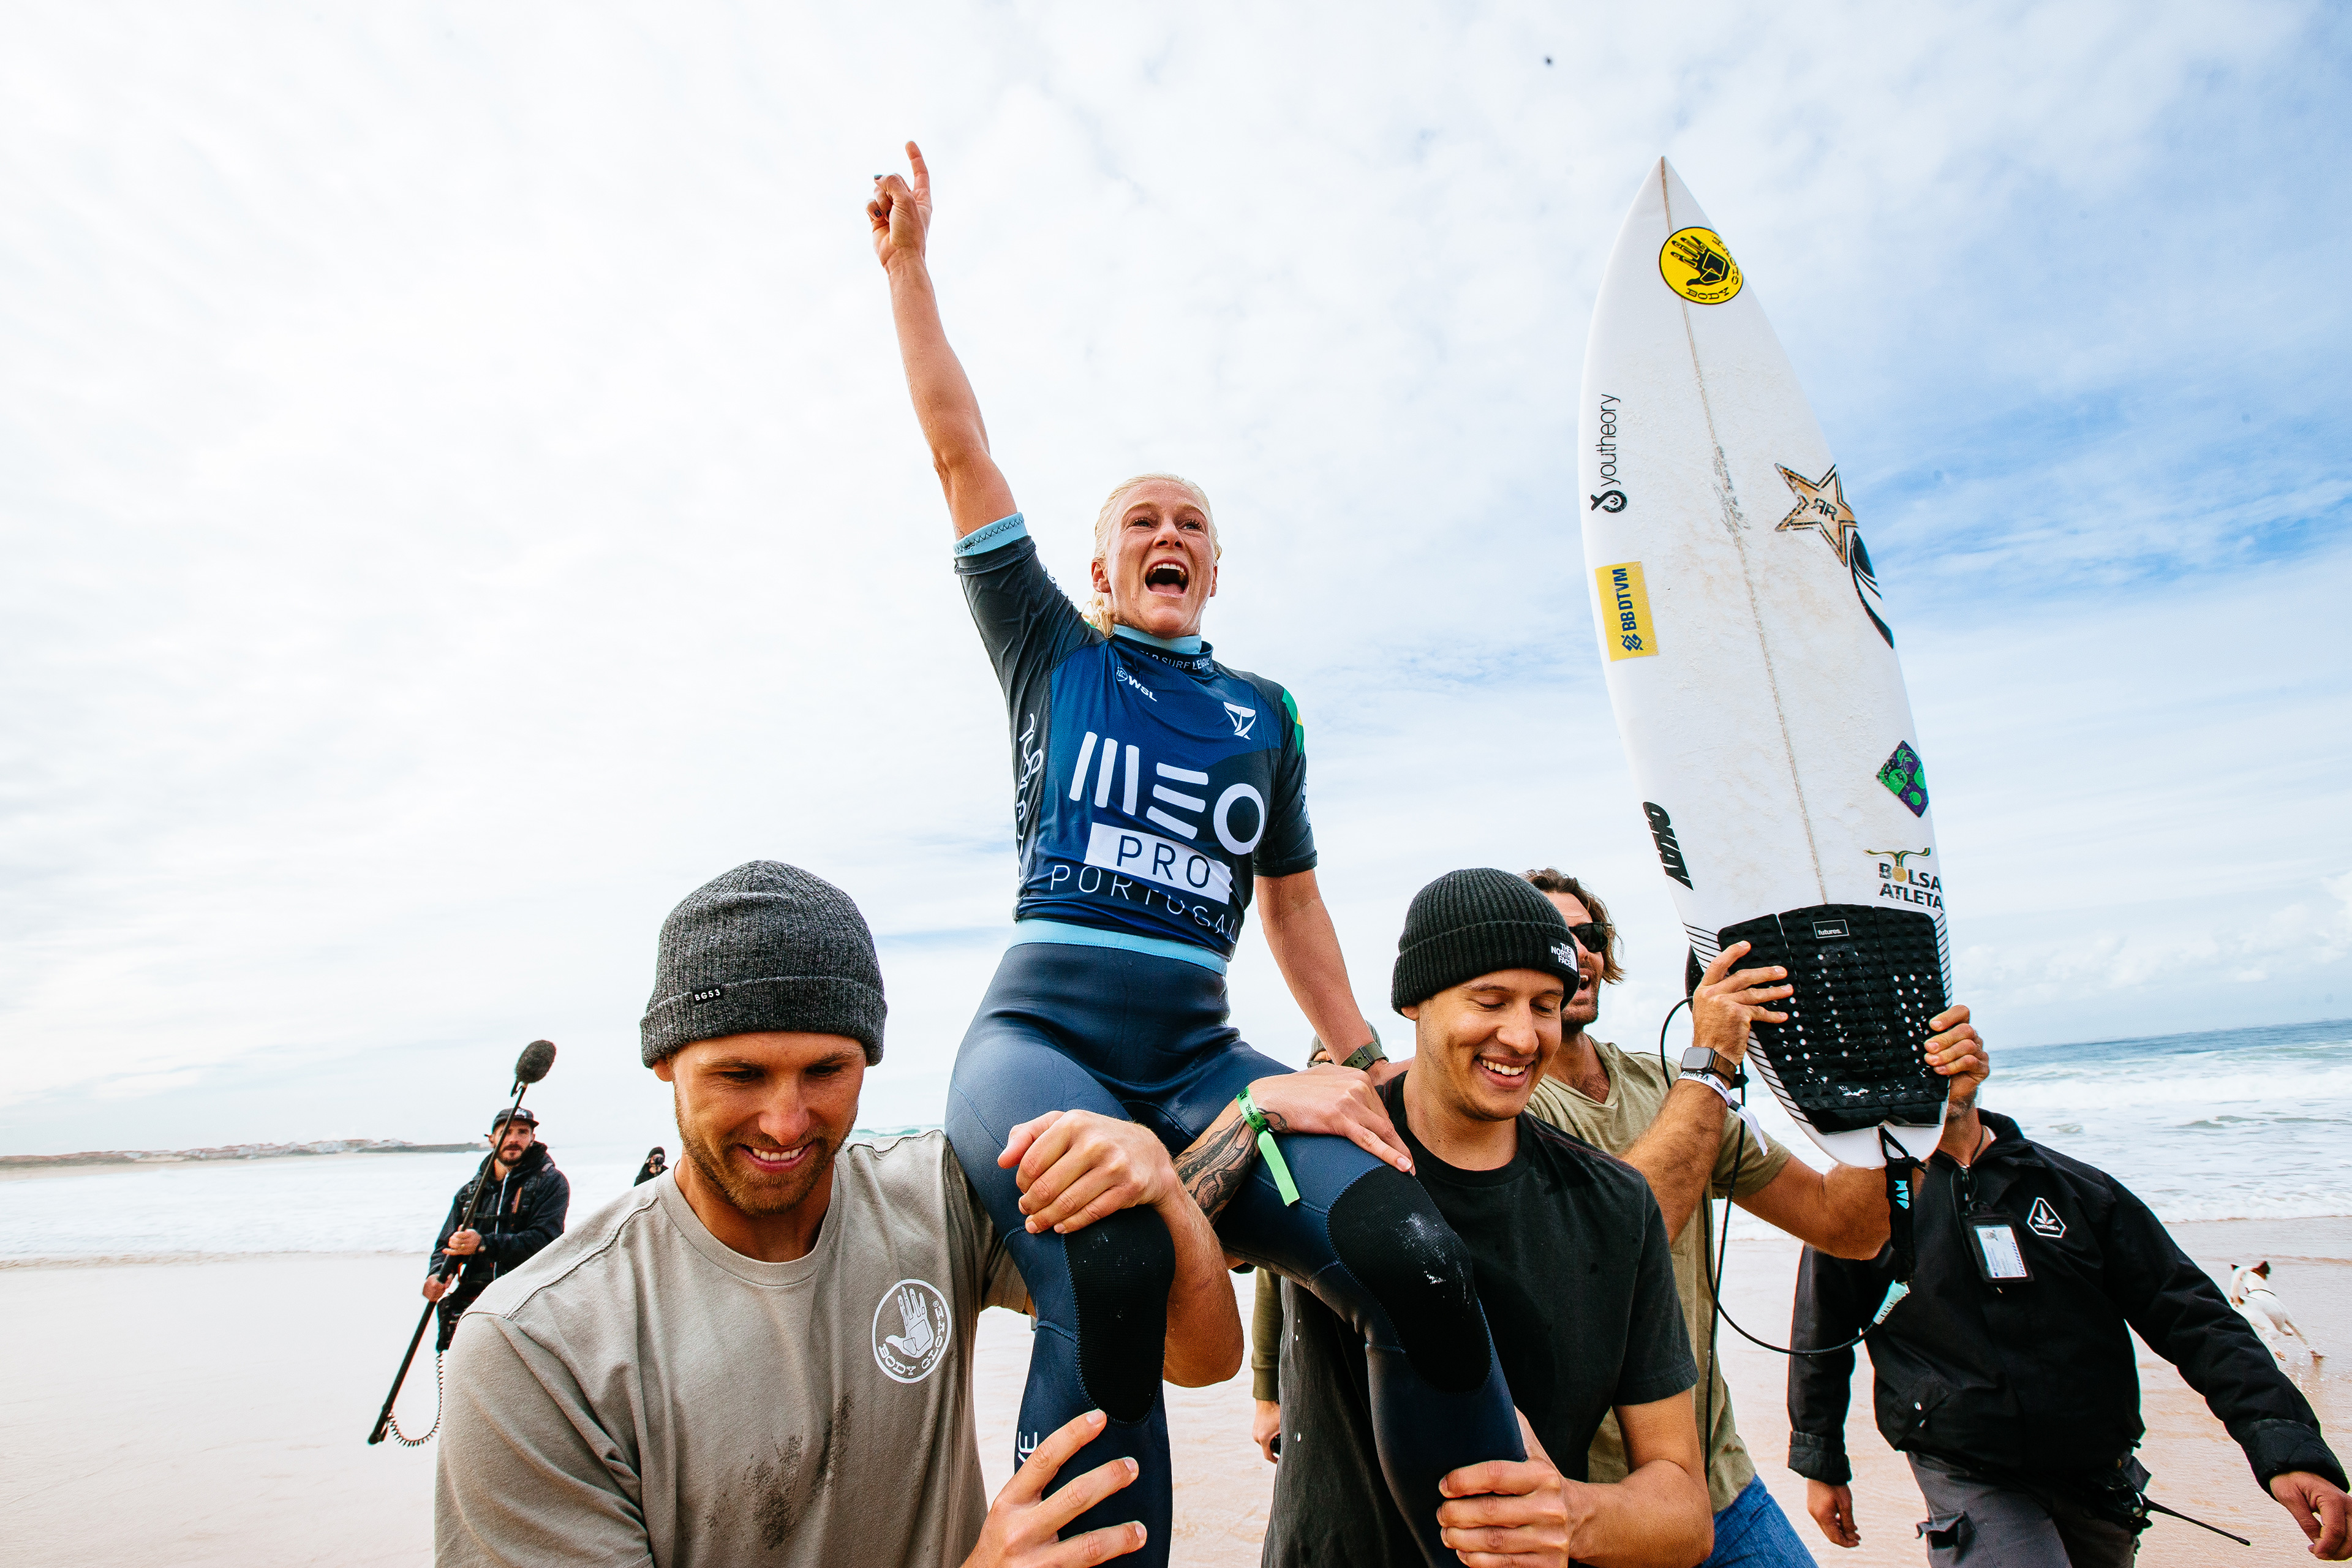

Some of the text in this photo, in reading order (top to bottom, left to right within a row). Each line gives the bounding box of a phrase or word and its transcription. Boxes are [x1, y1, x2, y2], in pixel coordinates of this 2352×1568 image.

[1686, 287, 1730, 300] BODY
[1595, 393, 1621, 487] youtheory
[1128, 674, 1158, 703] WSL
[1069, 731, 1265, 855] MEO
[1116, 834, 1211, 889] PRO
[1050, 864, 1237, 944] PORTUGAL
[1879, 882, 1944, 912] ATLETA
[1550, 946, 1572, 960] NORTH
[1558, 956, 1572, 968] FACE
[1560, 942, 1572, 953] THE
[694, 988, 721, 1001] BG53
[1245, 1103, 1254, 1118] WSL
[878, 1343, 917, 1376] BODY
